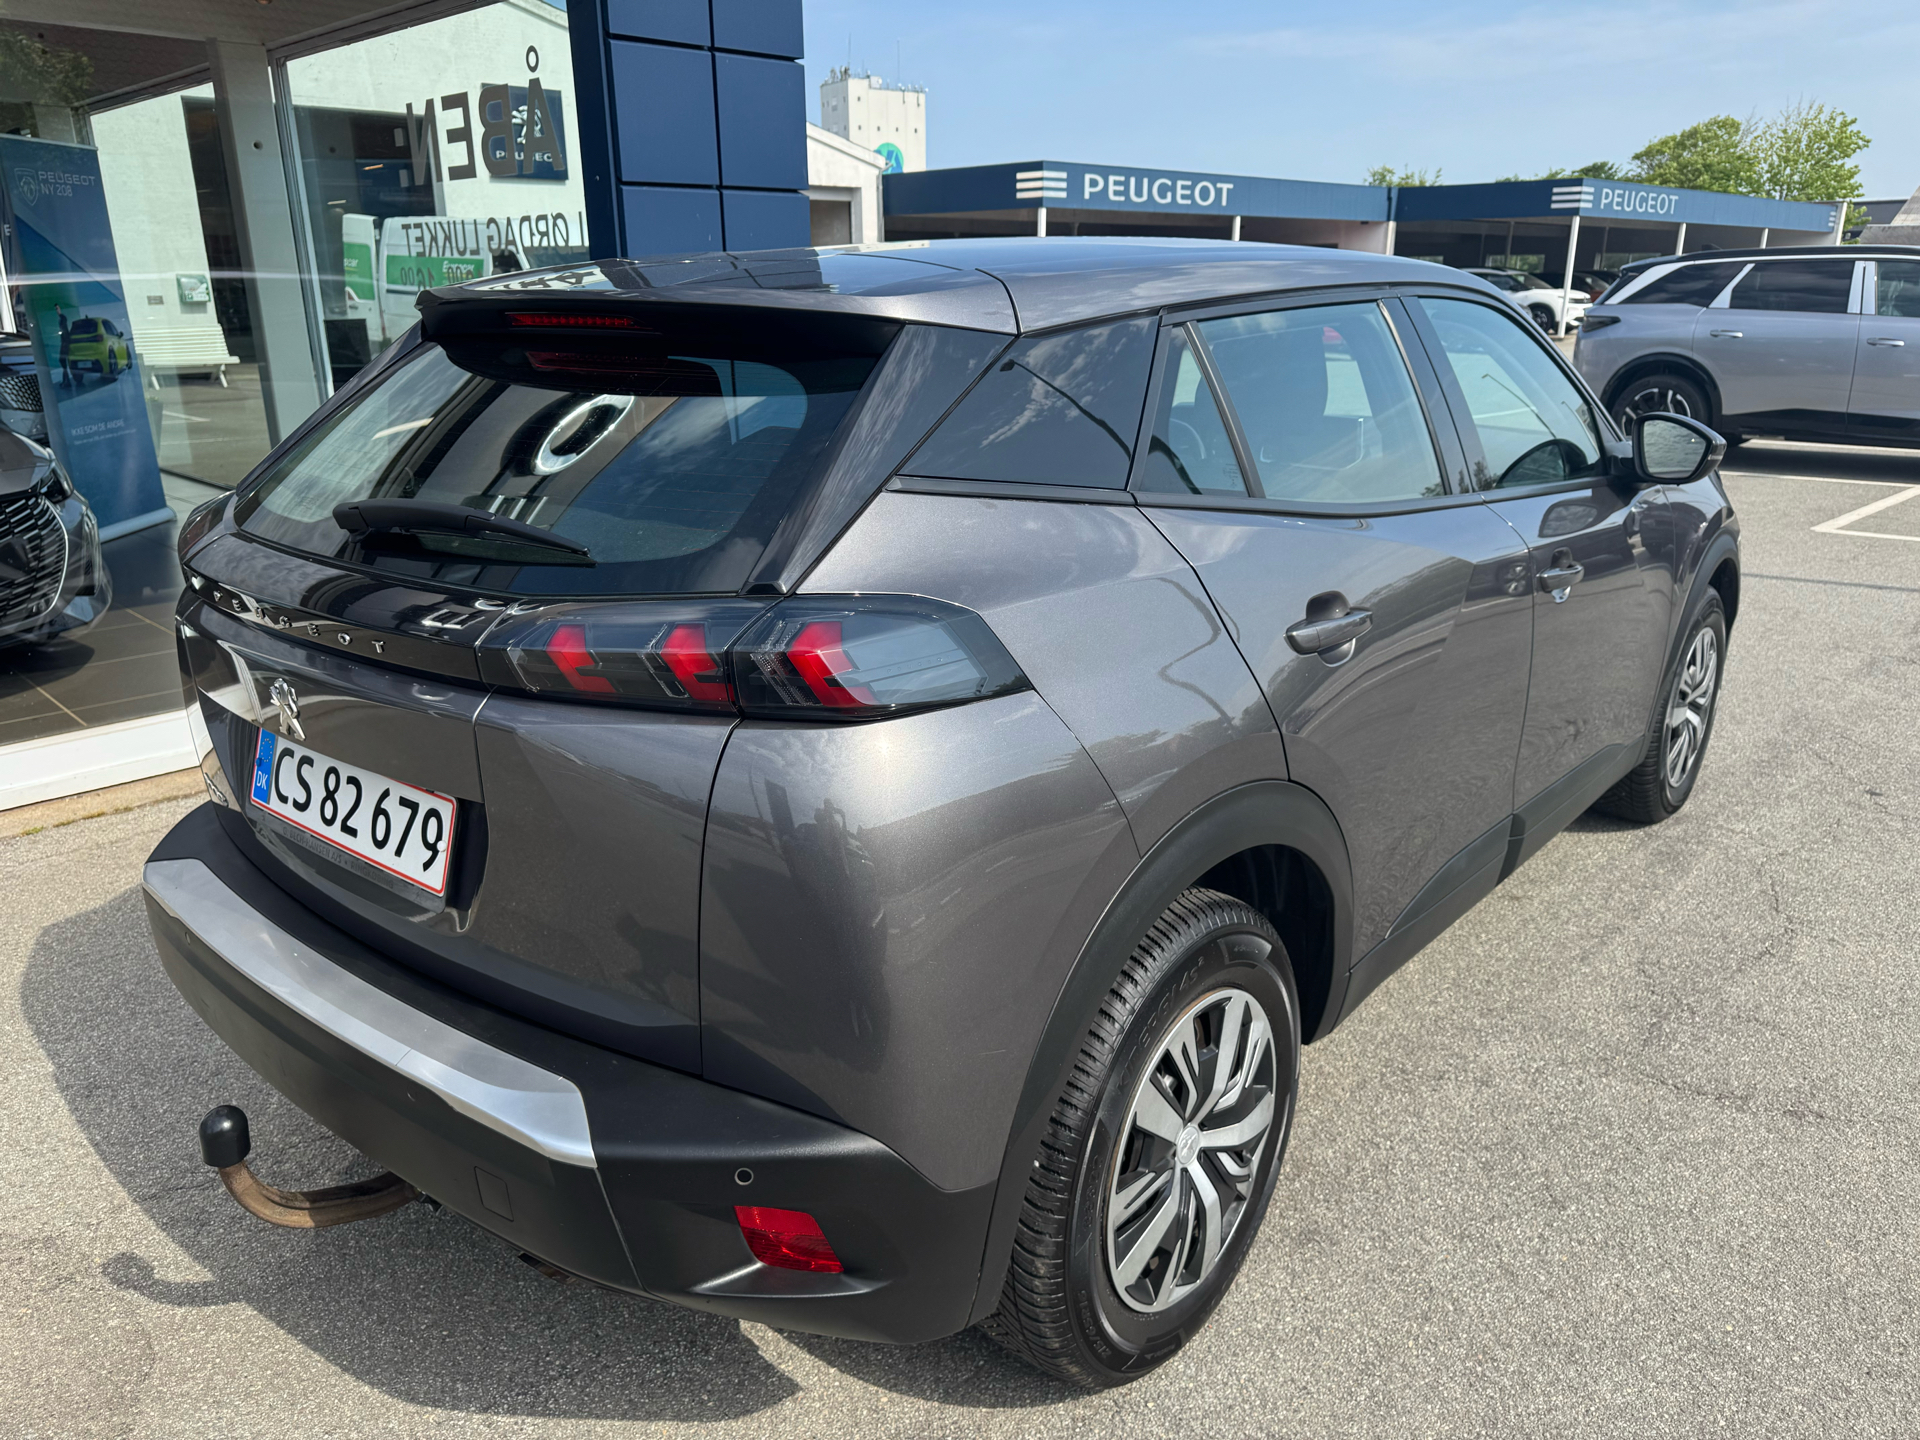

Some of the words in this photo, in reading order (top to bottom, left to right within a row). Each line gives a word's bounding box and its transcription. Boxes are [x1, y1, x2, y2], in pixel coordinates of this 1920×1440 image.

[38, 171, 96, 186] PEUGEOT
[40, 183, 54, 195] NY
[55, 184, 73, 197] 208
[1083, 173, 1234, 207] PEUGEOT
[1600, 188, 1679, 214] PEUGEOT
[213, 590, 385, 653] PEUGEOT
[256, 770, 268, 790] DK
[274, 747, 315, 812] CS
[320, 766, 363, 838] 82
[371, 787, 444, 872] 679
